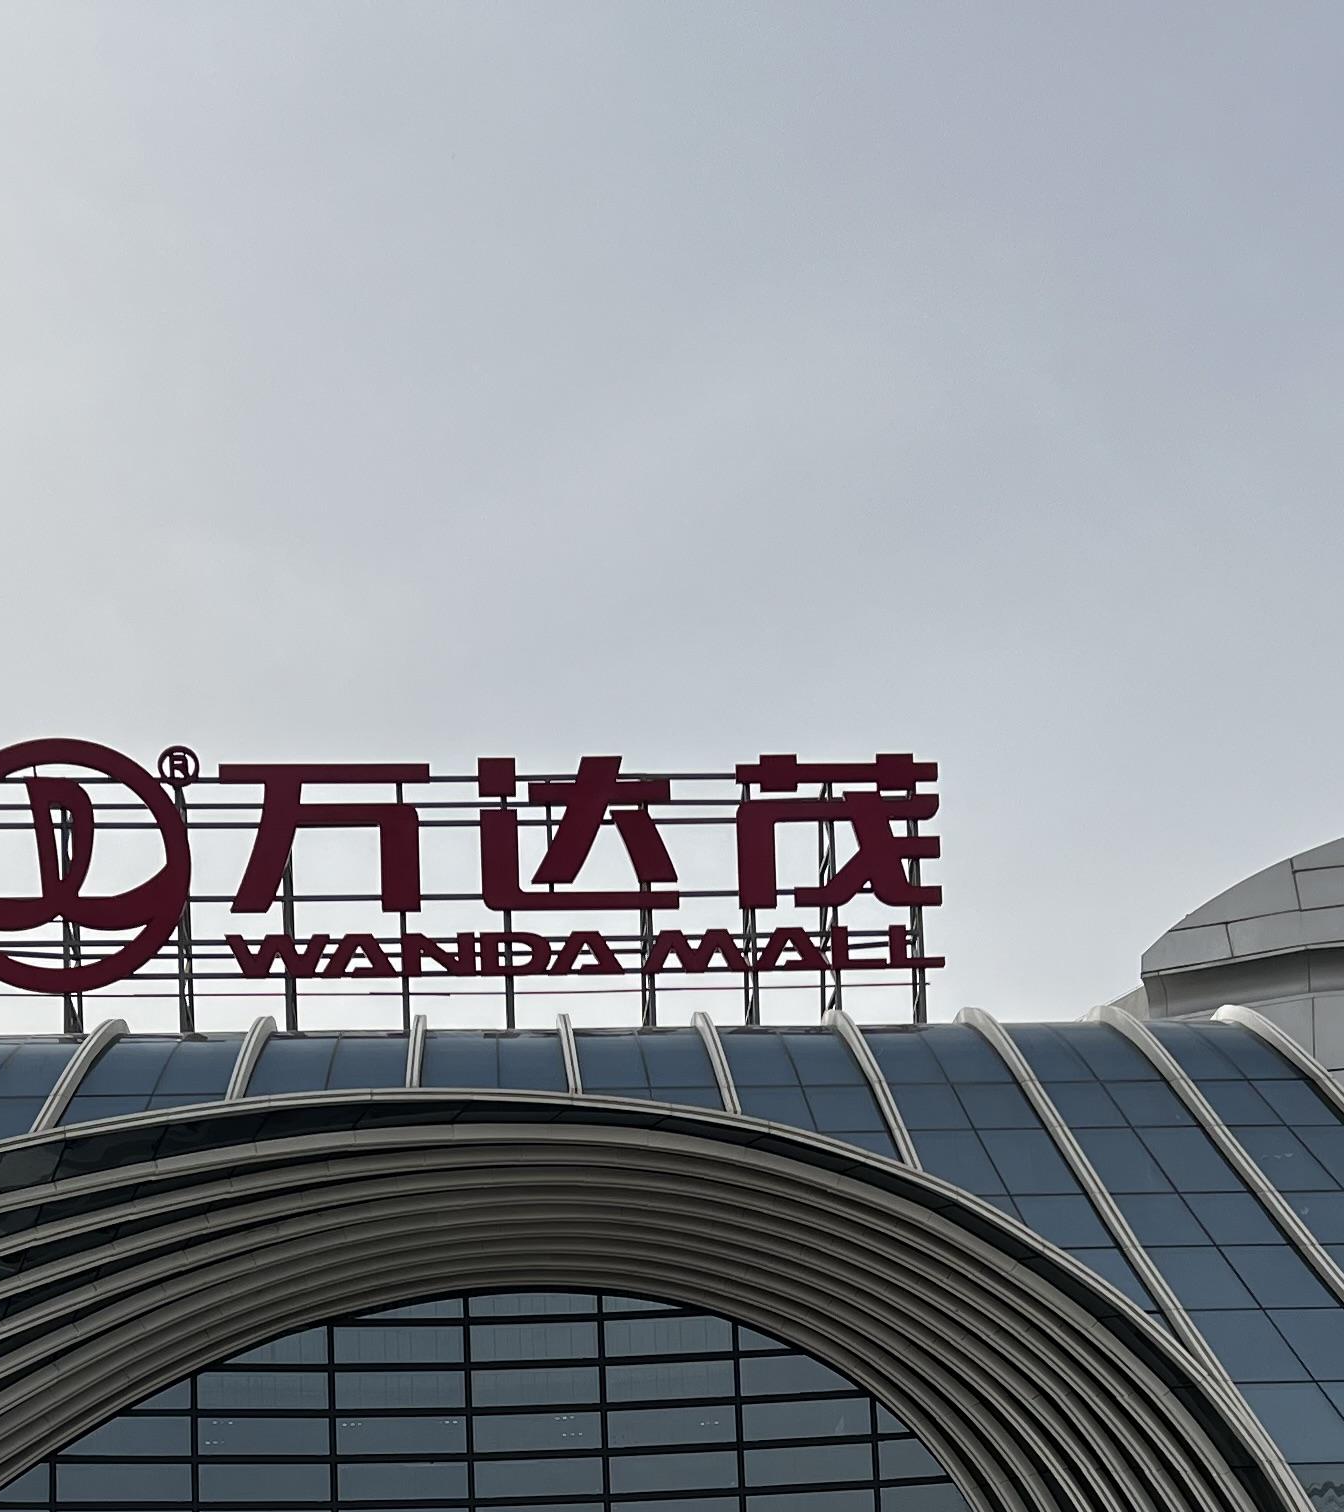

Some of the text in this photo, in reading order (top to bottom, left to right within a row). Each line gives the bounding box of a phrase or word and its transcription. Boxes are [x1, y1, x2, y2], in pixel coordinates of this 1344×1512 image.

[219, 753, 942, 912] 万达茂
[227, 925, 946, 979] WANDA MALL
